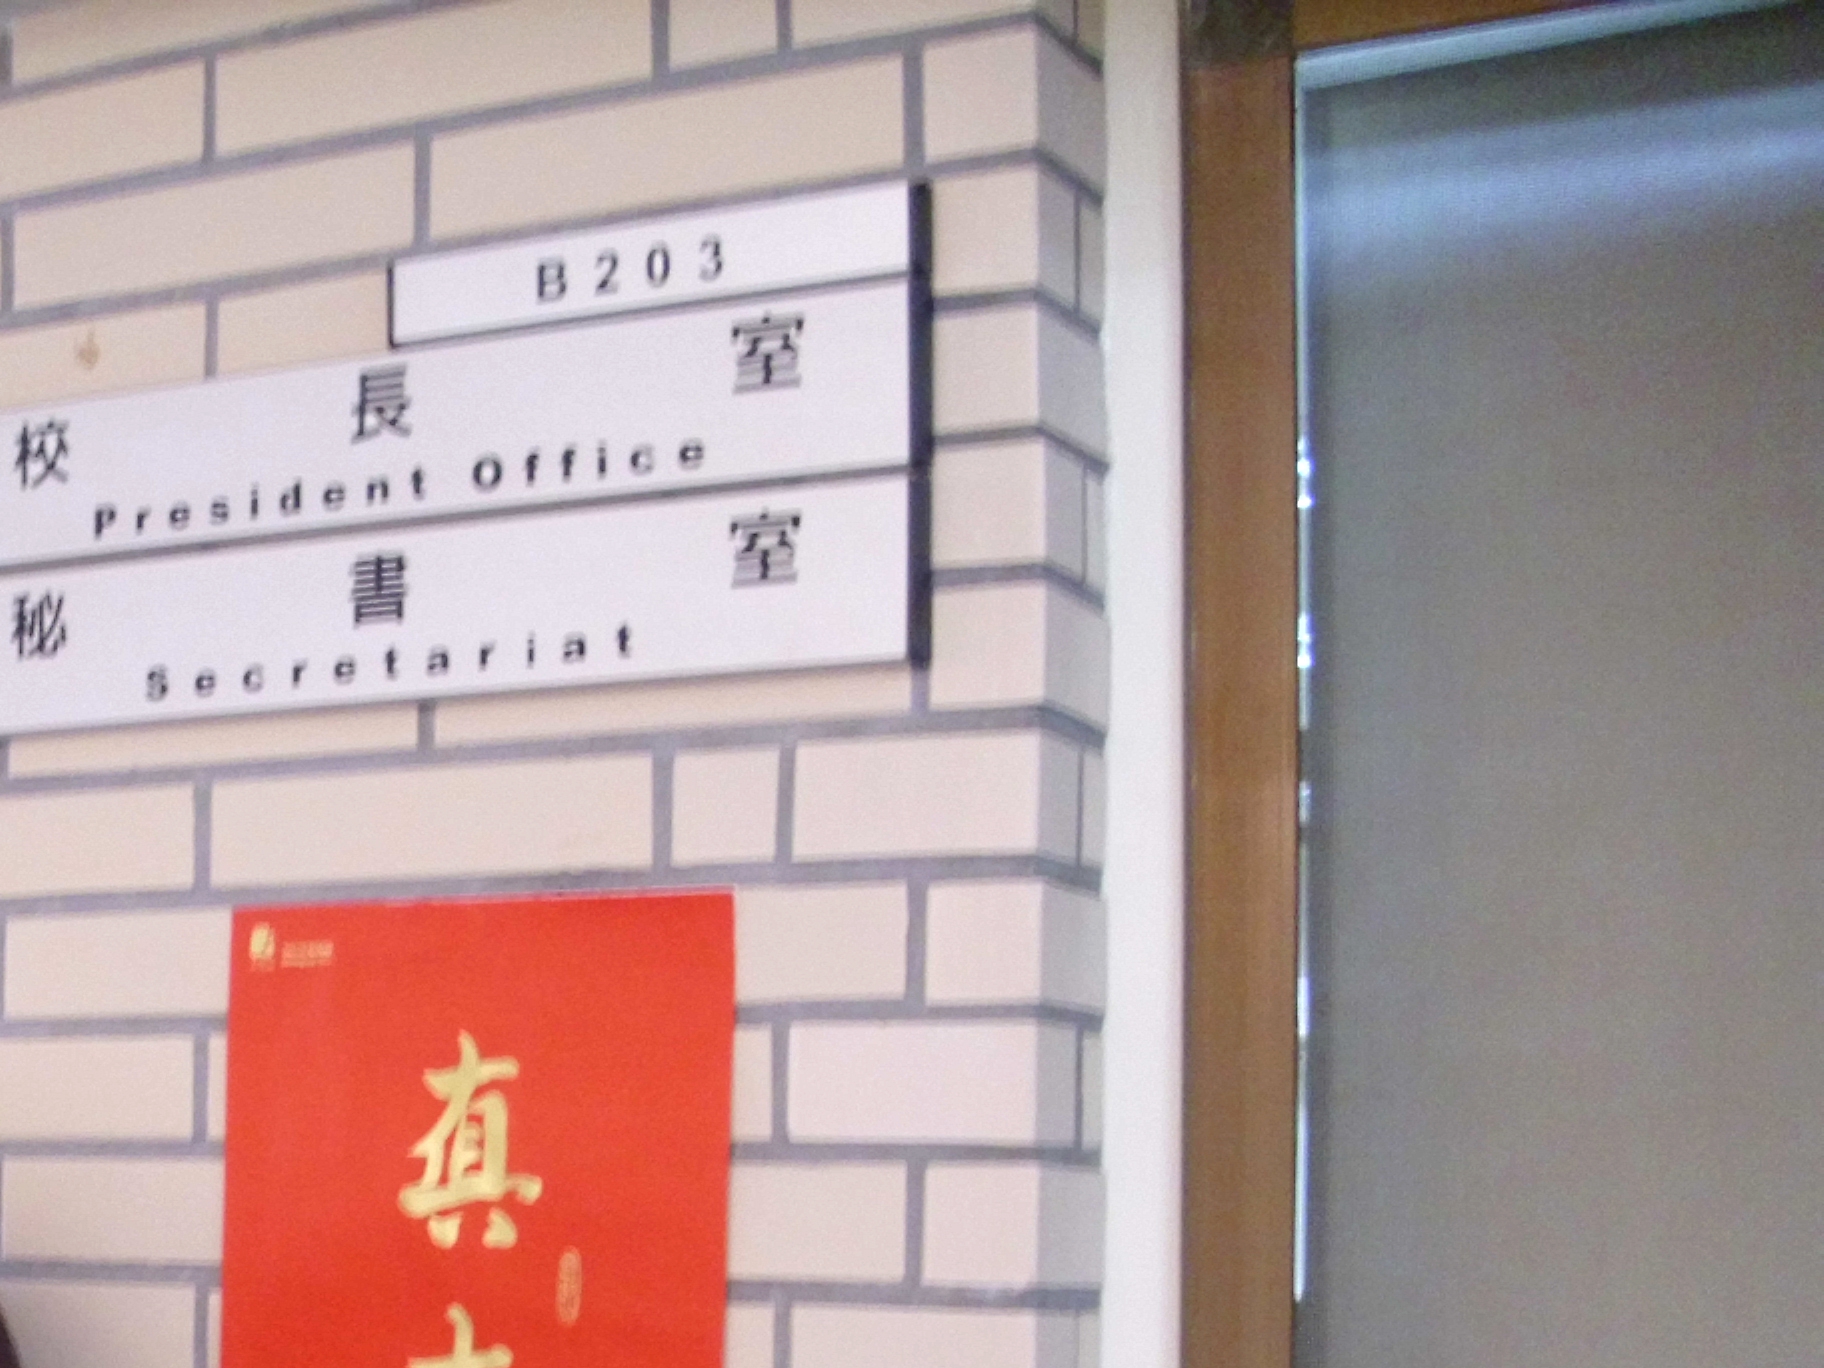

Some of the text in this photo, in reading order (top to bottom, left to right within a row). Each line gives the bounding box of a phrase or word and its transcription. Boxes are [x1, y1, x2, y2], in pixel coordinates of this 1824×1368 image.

[536, 235, 726, 304] B203
[93, 437, 707, 540] President Office
[146, 623, 631, 701] Secretariat
